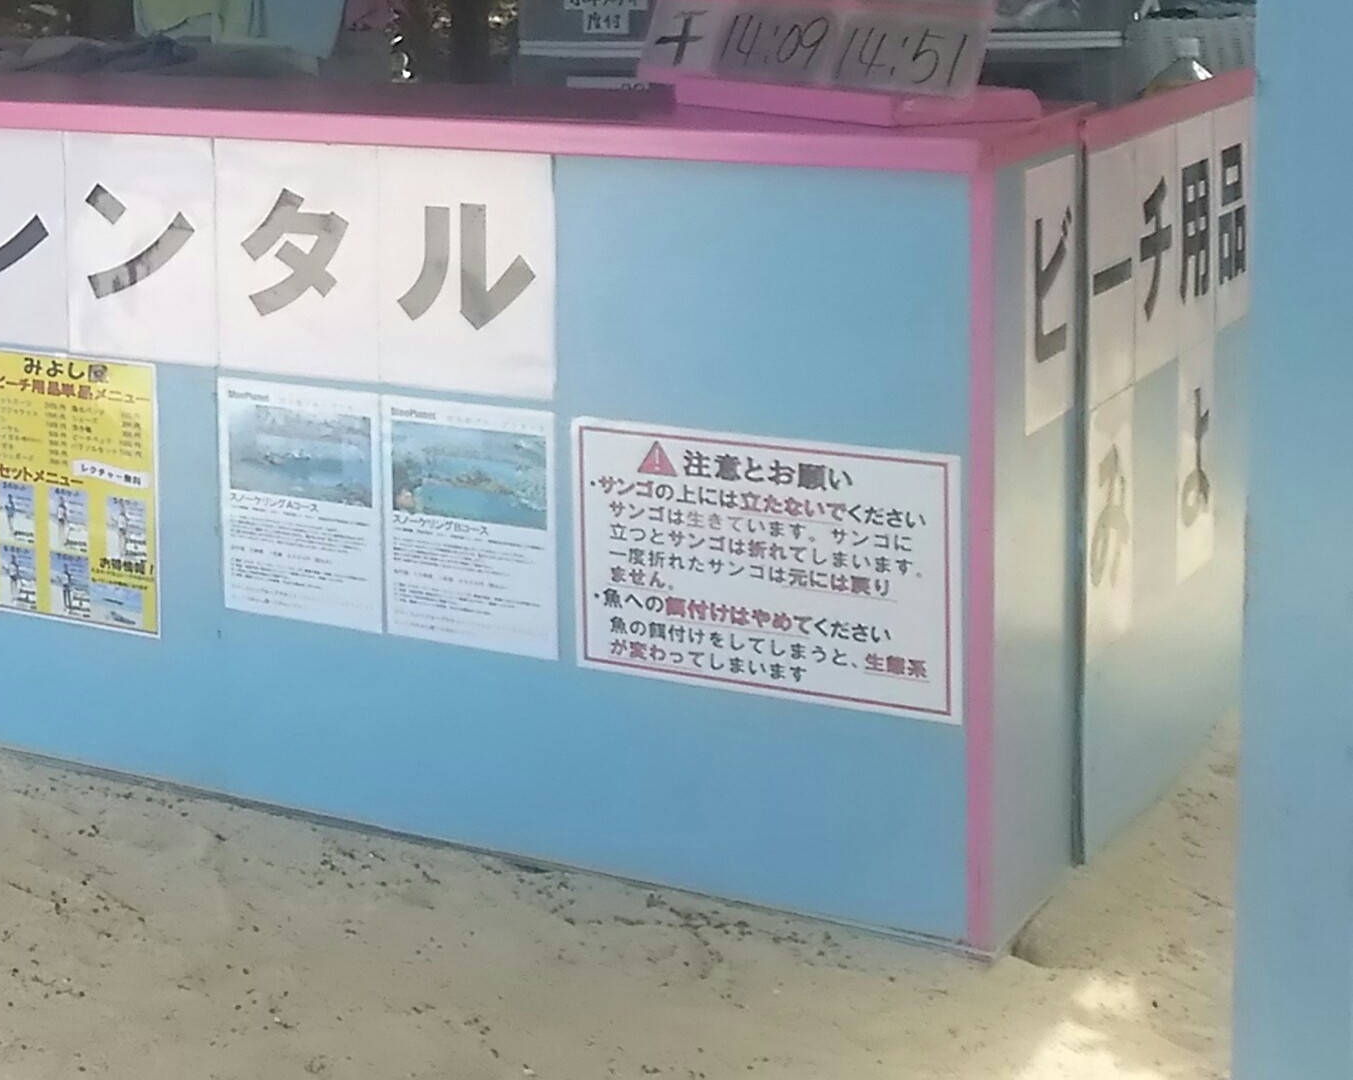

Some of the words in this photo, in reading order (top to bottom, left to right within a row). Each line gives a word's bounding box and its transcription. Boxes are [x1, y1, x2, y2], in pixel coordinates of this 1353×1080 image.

[655, 9, 708, 66] 干
[719, 14, 829, 67] 14:09
[835, 26, 969, 88] 14:51
[1035, 142, 1247, 364] ビーチ用品
[80, 463, 143, 487] レクチャー無料
[682, 448, 854, 492] 注意とお願い
[609, 615, 930, 680] 魚の餌付けをしてしまうと、生態系
[610, 639, 807, 683] が変わってしまいます
